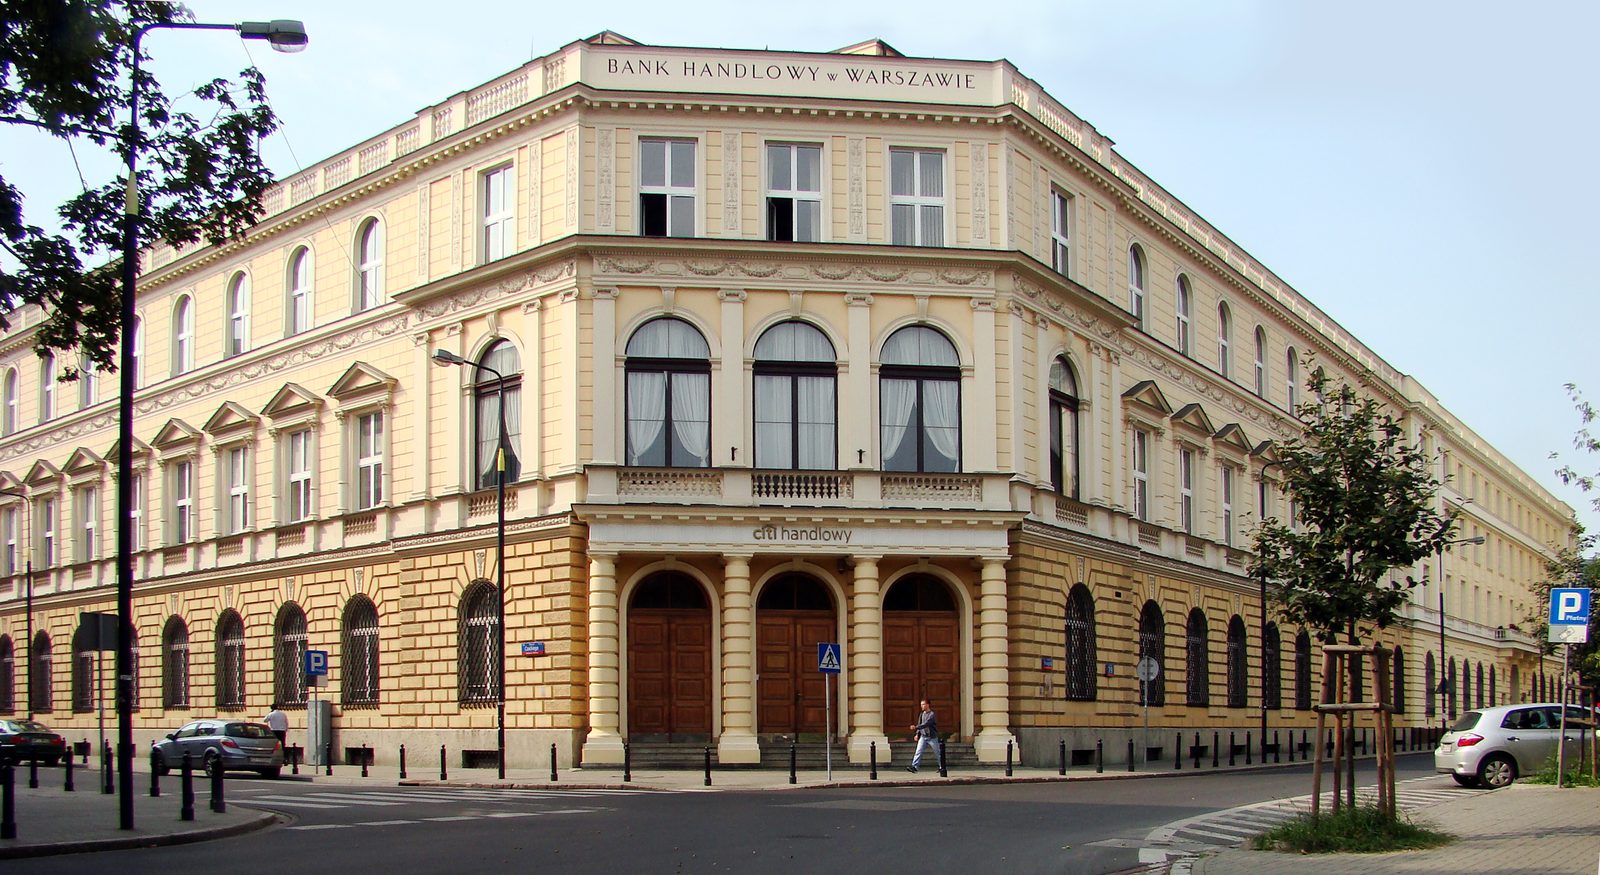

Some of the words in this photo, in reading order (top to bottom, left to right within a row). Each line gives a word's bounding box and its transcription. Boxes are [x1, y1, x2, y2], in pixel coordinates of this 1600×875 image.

[607, 58, 671, 76] BANK
[683, 61, 820, 82] HANDLOWY
[845, 68, 976, 89] WARSZAWIE
[753, 525, 777, 540] citi
[781, 527, 852, 543] handlowy
[1558, 592, 1582, 620] P
[310, 653, 324, 671] P
